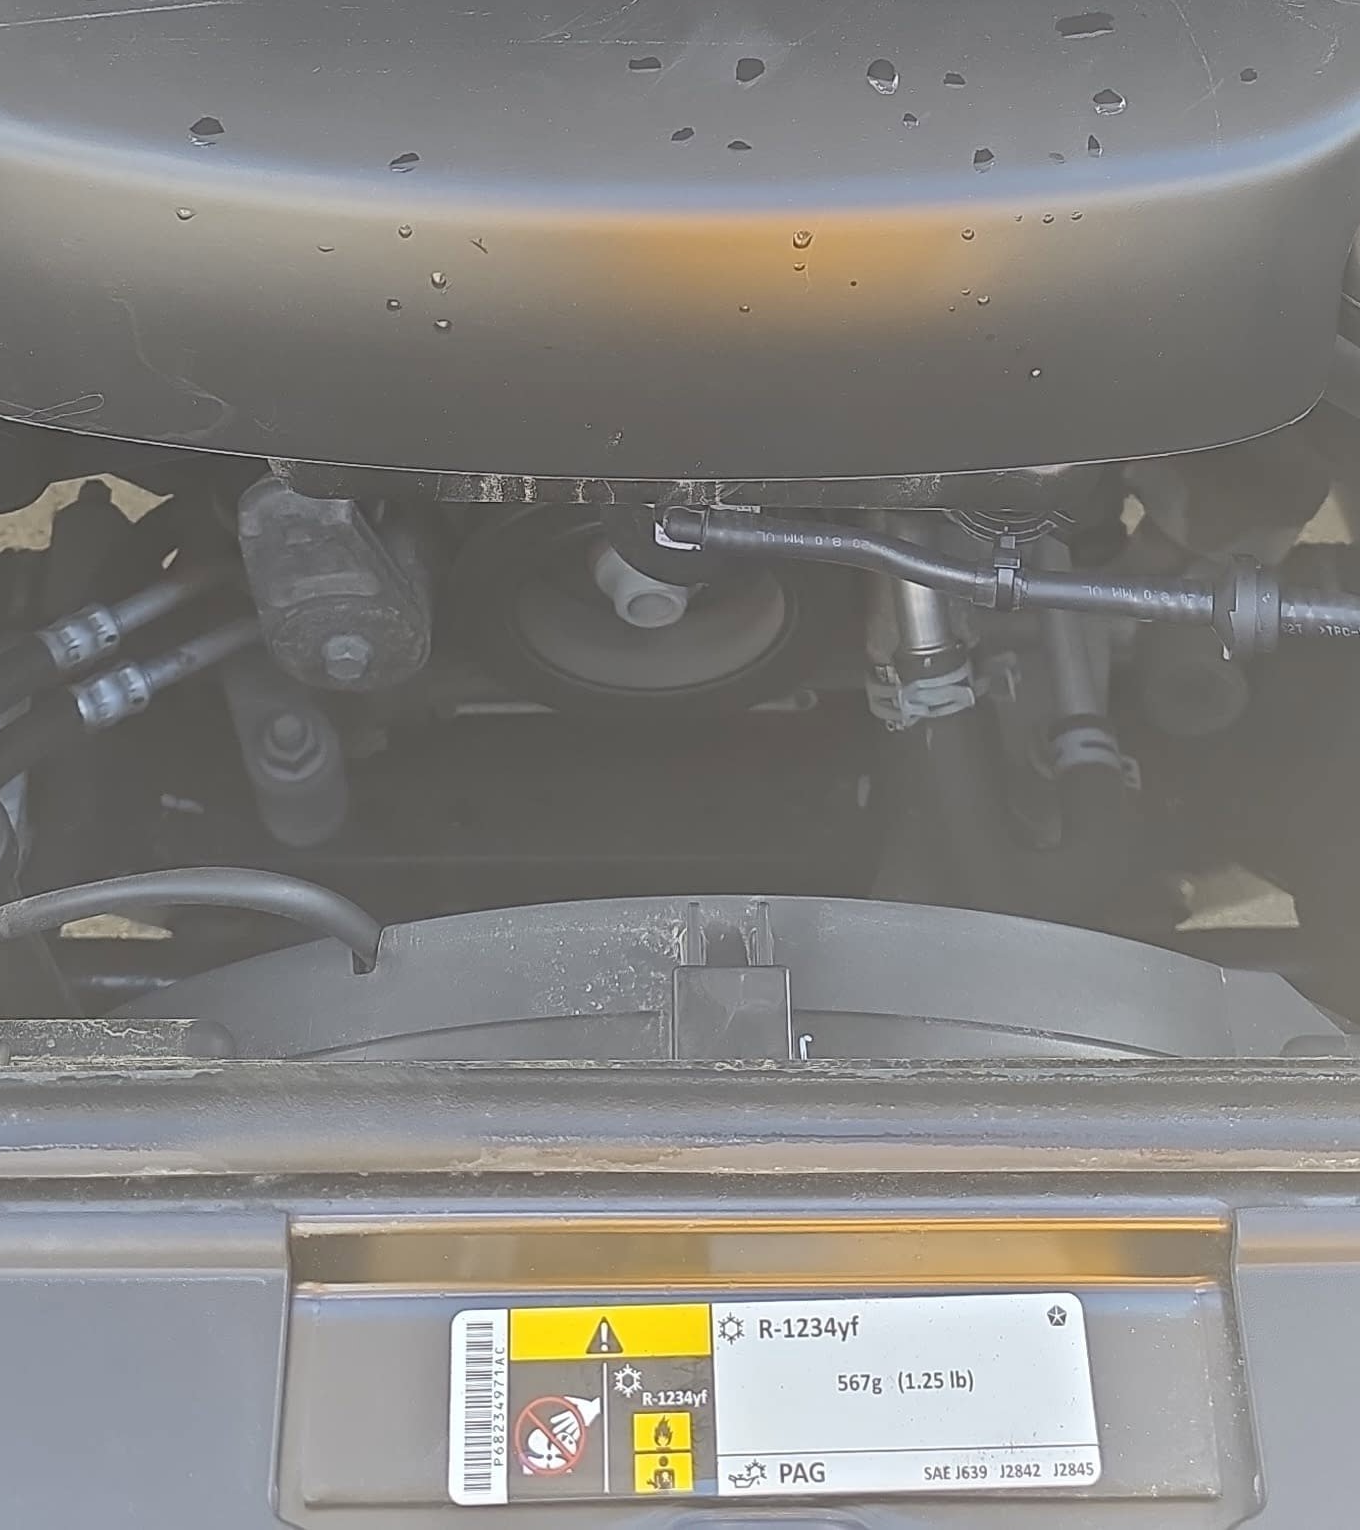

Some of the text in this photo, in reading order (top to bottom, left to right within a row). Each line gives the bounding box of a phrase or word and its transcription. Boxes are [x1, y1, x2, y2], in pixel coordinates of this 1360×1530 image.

[783, 534, 804, 545] MM
[815, 535, 842, 547] 8.0
[758, 1315, 861, 1342] R-1234yf
[837, 1369, 975, 1395] 567g (1.25 lb)
[494, 1346, 506, 1467] P68234971AC
[641, 1389, 709, 1408] R-1234yf
[779, 1461, 826, 1484] PAG
[924, 1462, 1095, 1480] SAE J639 J2842 J2845
